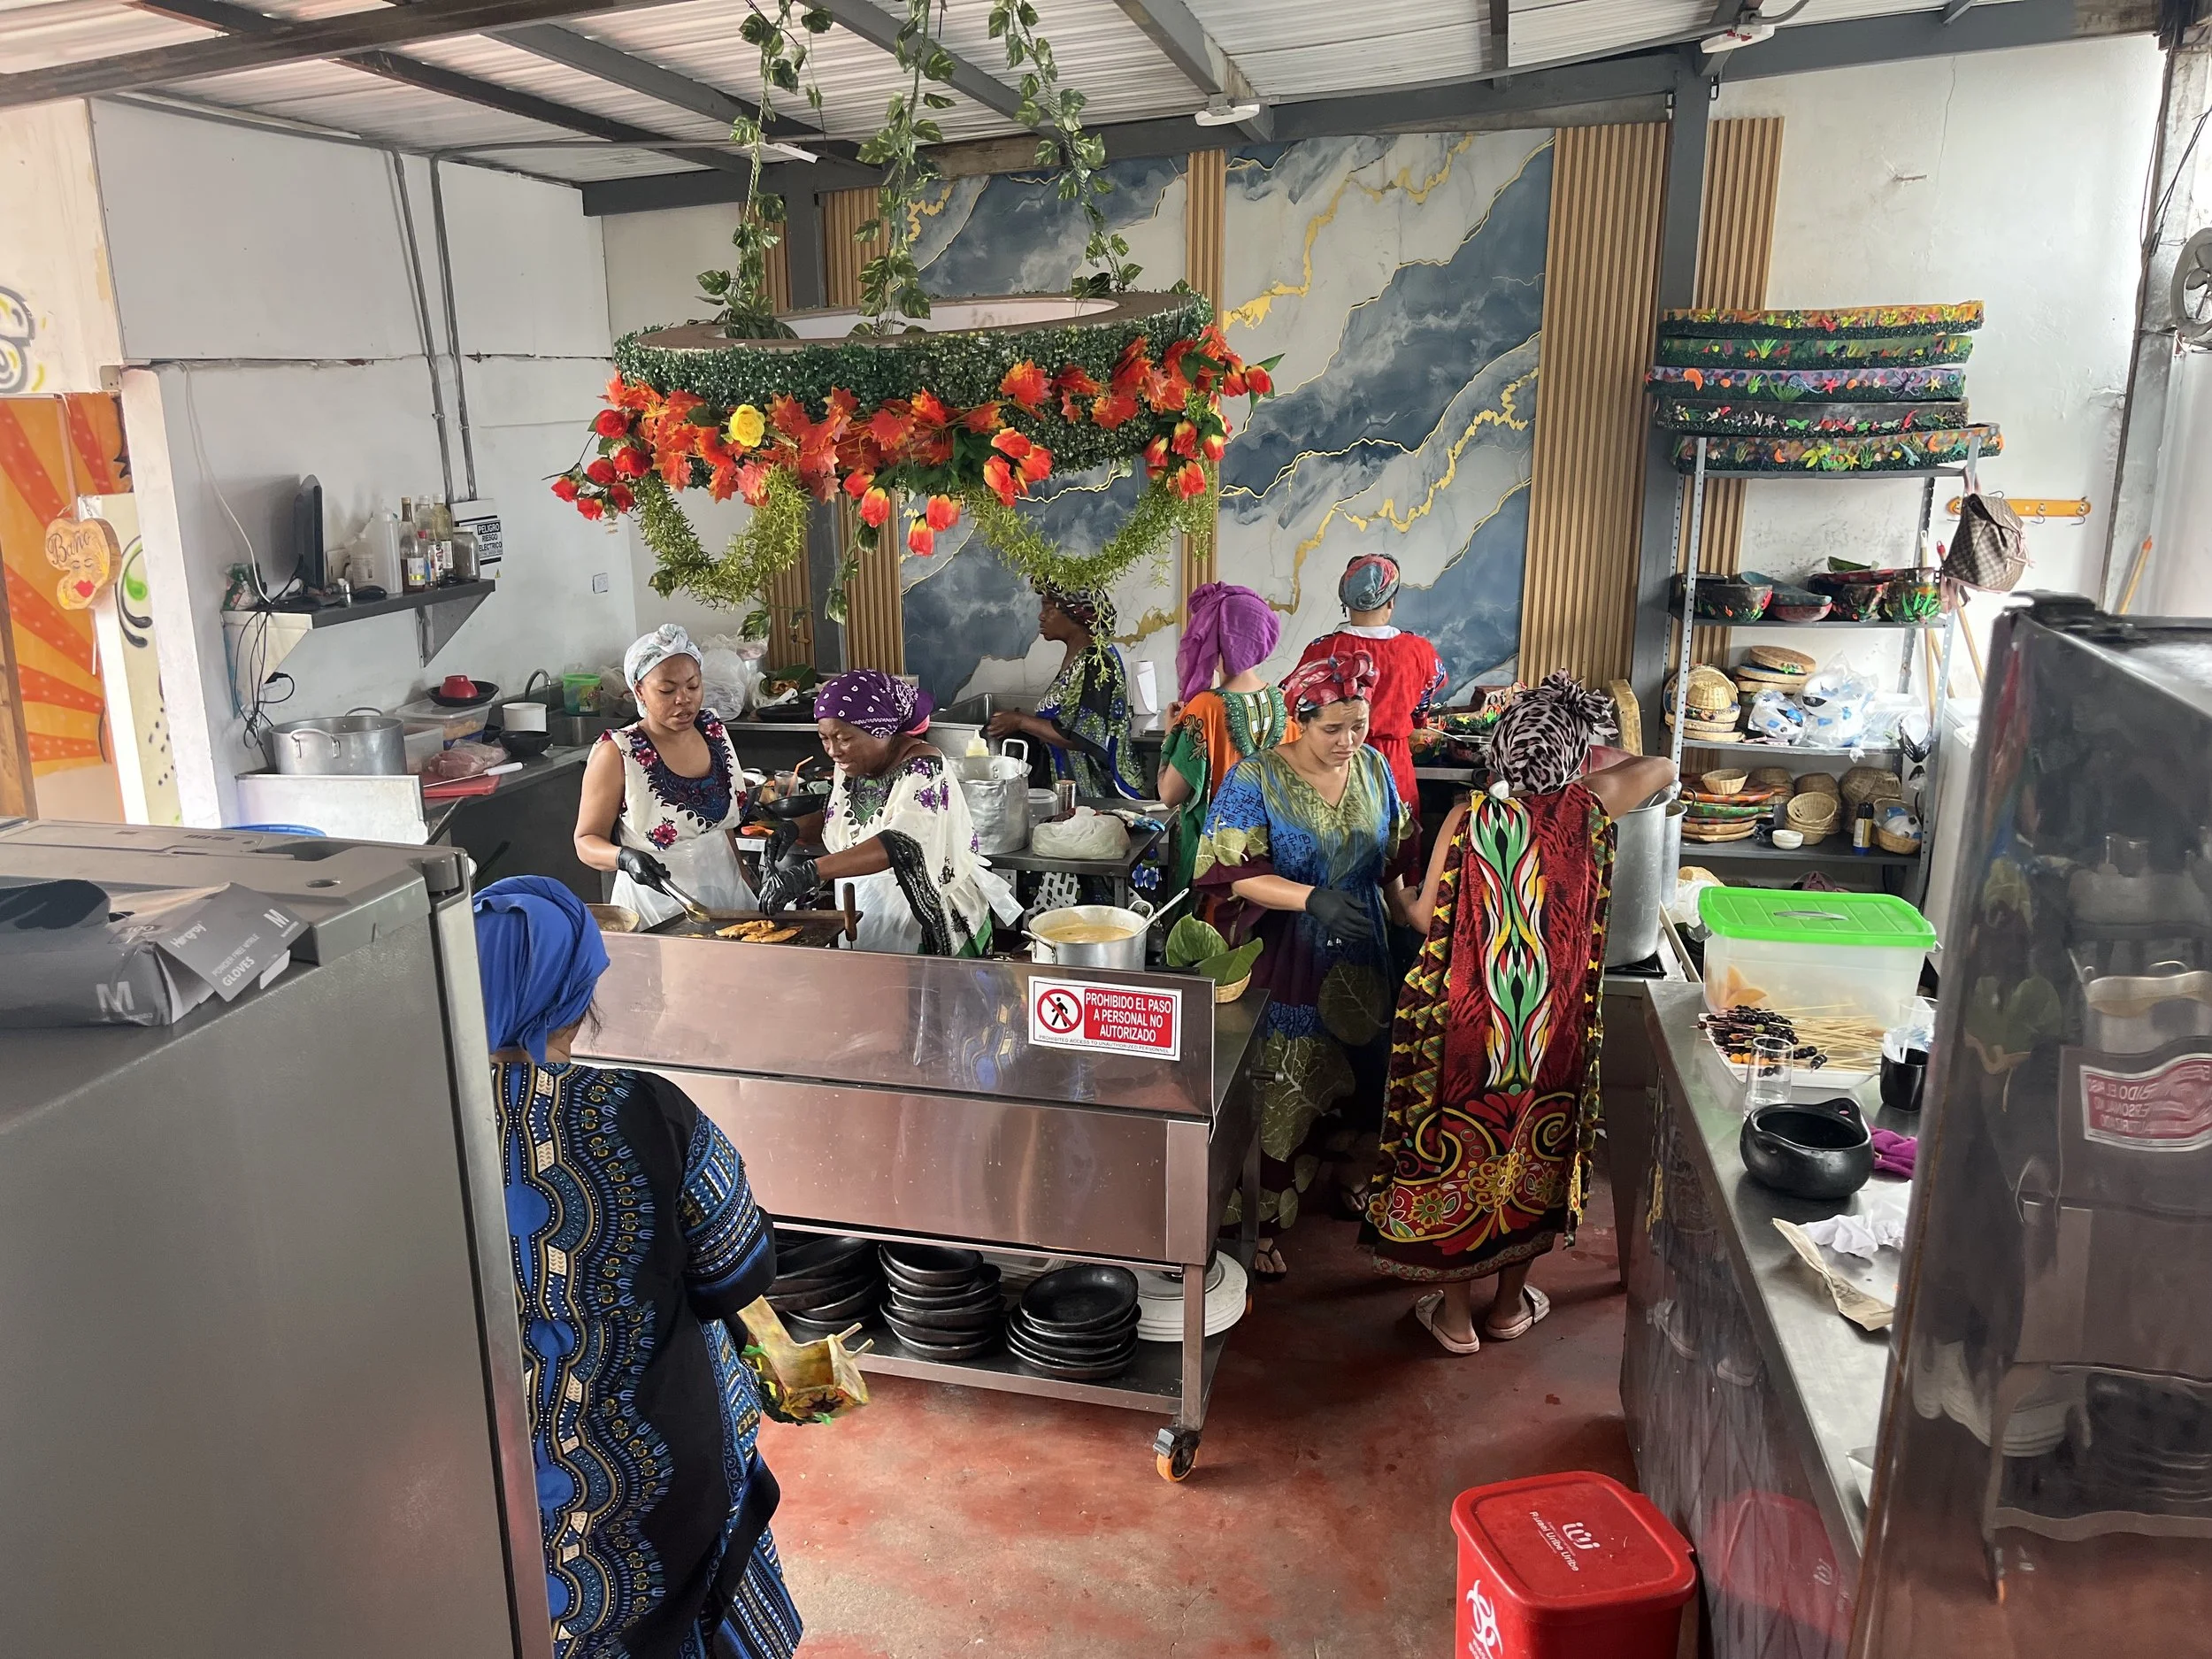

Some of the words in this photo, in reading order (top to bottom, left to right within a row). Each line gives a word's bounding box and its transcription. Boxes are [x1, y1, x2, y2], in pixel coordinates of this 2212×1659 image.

[478, 523, 500, 534] PELIGRO
[48, 531, 90, 565] Baño
[263, 909, 289, 928] M
[231, 945, 246, 958] FREE
[222, 956, 255, 987] GLOVES
[96, 980, 134, 1012] M
[1086, 993, 1133, 1010] PROHIBIDO
[1135, 997, 1146, 1010] EL
[1148, 999, 1171, 1013] PASO
[1094, 1008, 1100, 1021] A
[1102, 1009, 1148, 1026] PERSONAL
[1149, 1014, 1163, 1028] NO
[1100, 1025, 1156, 1042] AUTORIZADO
[1039, 1034, 1068, 1043] PROHIBITED
[1099, 1041, 1138, 1050] UNAUTHORIZED
[1139, 1045, 1169, 1054] PERSONNEL
[1546, 1532, 1563, 1551] Uribe
[1561, 1551, 1579, 1571] Uribe
